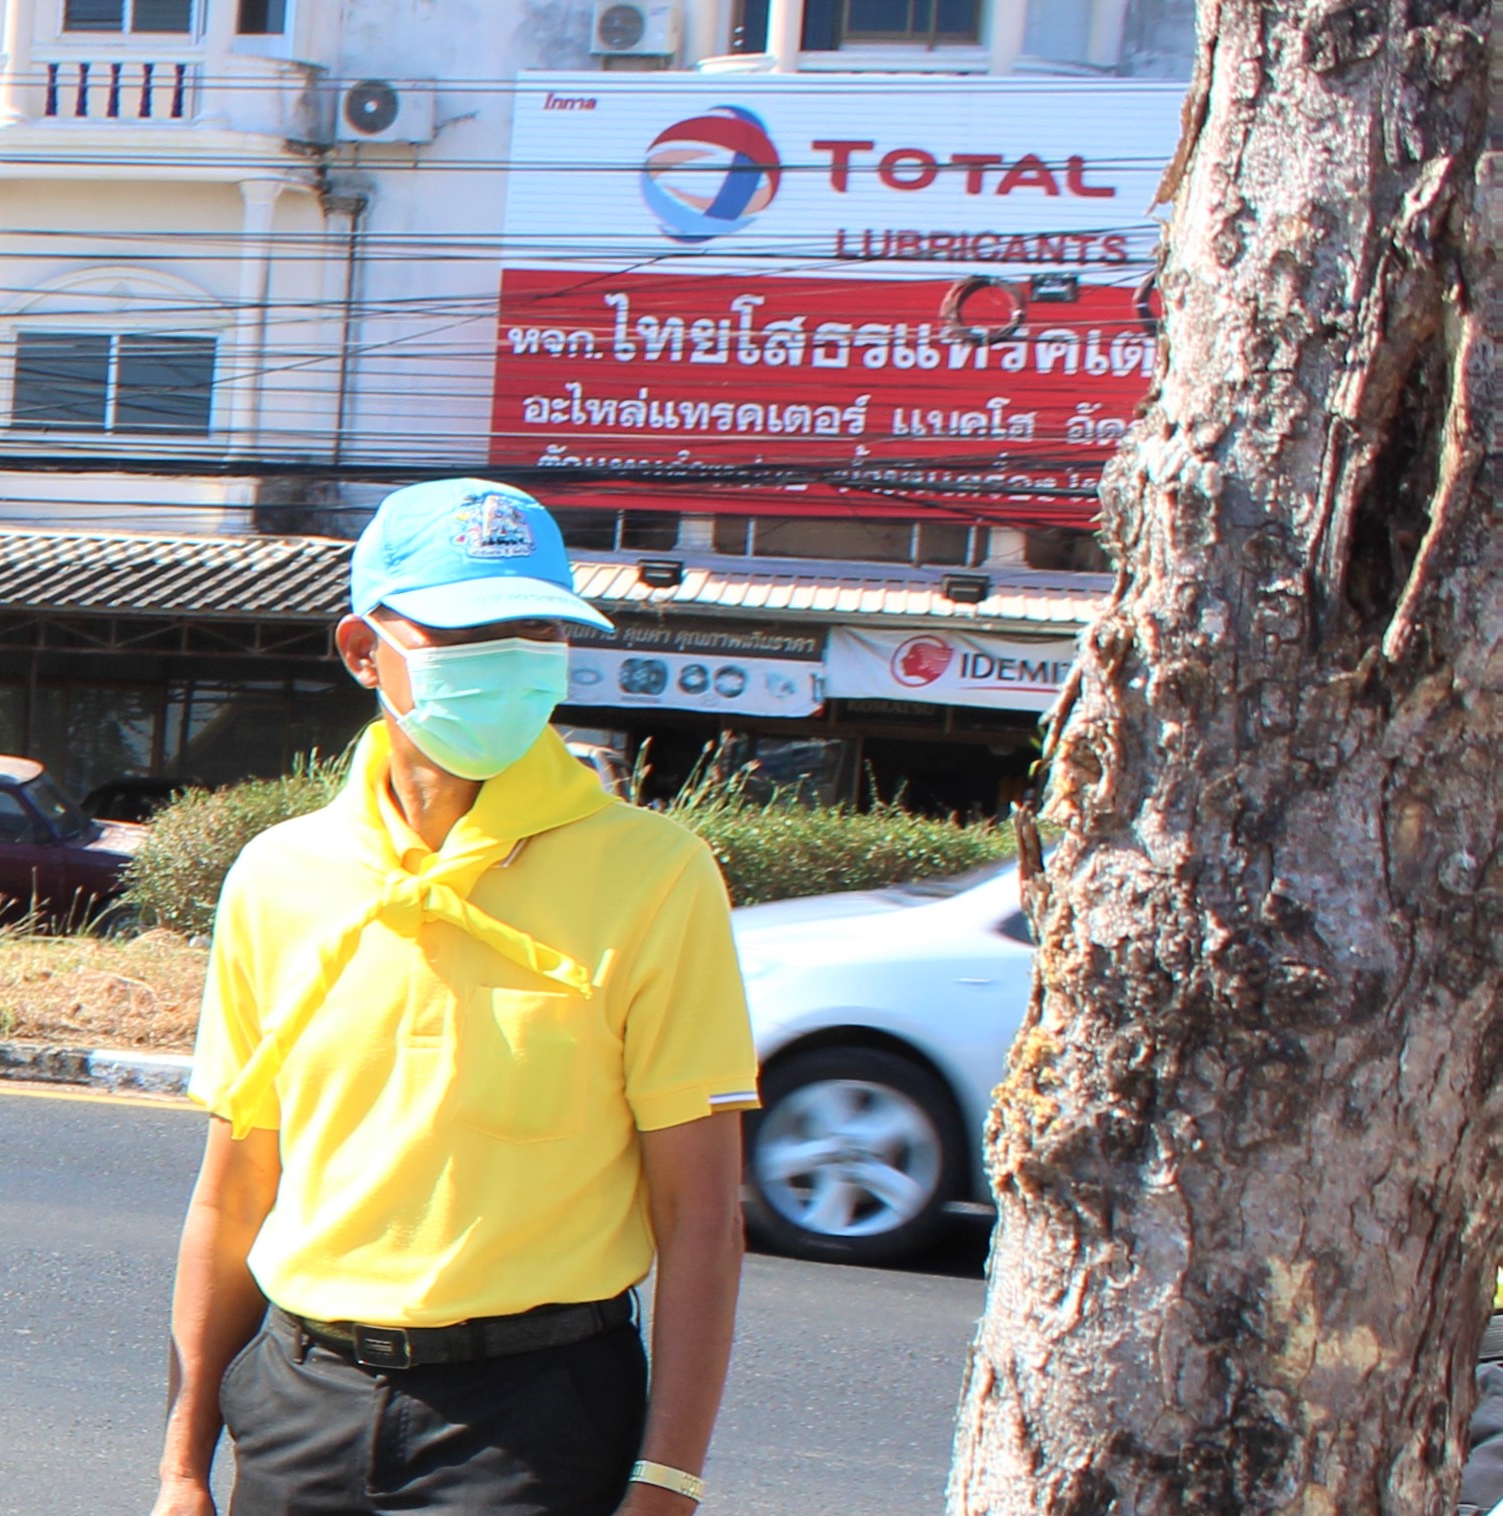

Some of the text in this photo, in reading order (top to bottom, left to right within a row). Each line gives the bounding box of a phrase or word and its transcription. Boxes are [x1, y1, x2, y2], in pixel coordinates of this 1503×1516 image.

[811, 139, 1117, 198] TOTAL
[835, 227, 1129, 267] LUBRICANTS
[604, 292, 1157, 378] ไทยโสธรแทรคเต
[522, 381, 872, 436] อะไหล่แทรคเตอร์
